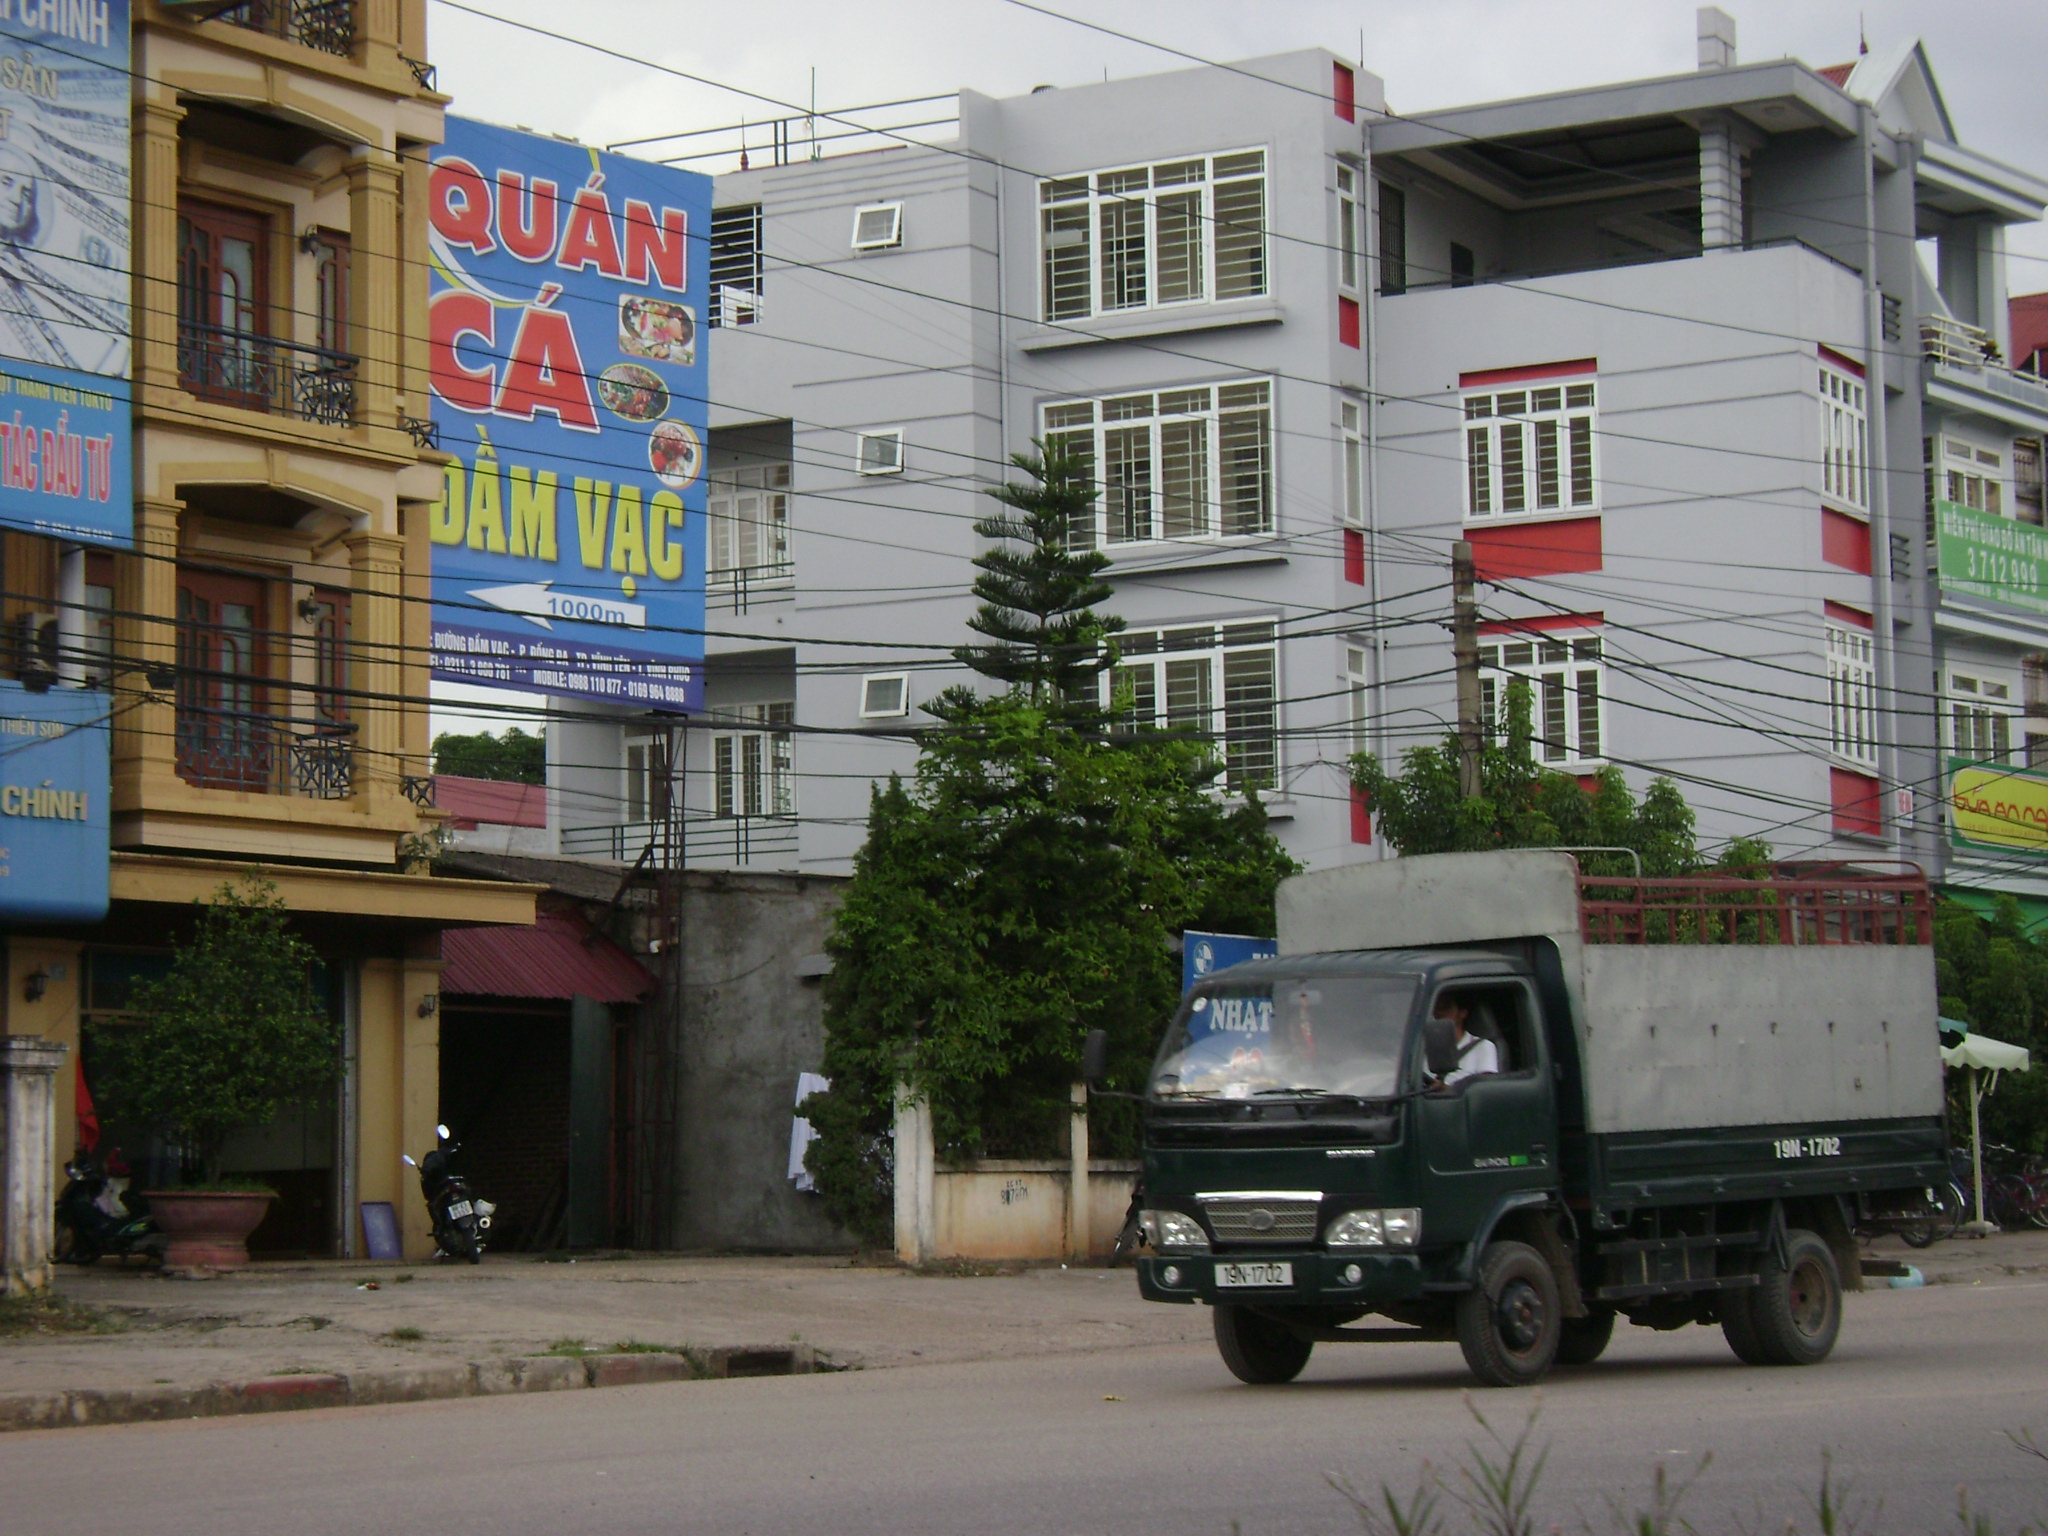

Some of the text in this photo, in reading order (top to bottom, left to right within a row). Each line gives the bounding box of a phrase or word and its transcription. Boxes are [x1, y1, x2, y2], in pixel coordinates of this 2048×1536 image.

[2, 51, 59, 100] SẢN
[429, 156, 687, 293] QUÁN
[429, 282, 600, 434] CÁ
[16, 375, 50, 400] THÀNH
[53, 382, 77, 405] VIÊN
[0, 409, 113, 503] TÁC ĐẦU TƯ
[430, 424, 683, 598] ĐẦM VẠC
[547, 597, 626, 625] 1000m
[534, 669, 568, 689] MOBILE:
[590, 676, 606, 693] 110
[606, 678, 621, 695] 877
[2, 779, 88, 822] CHÍNH
[1773, 1137, 1840, 1159] 19N-1702
[1224, 1265, 1284, 1285] 19N-1702
